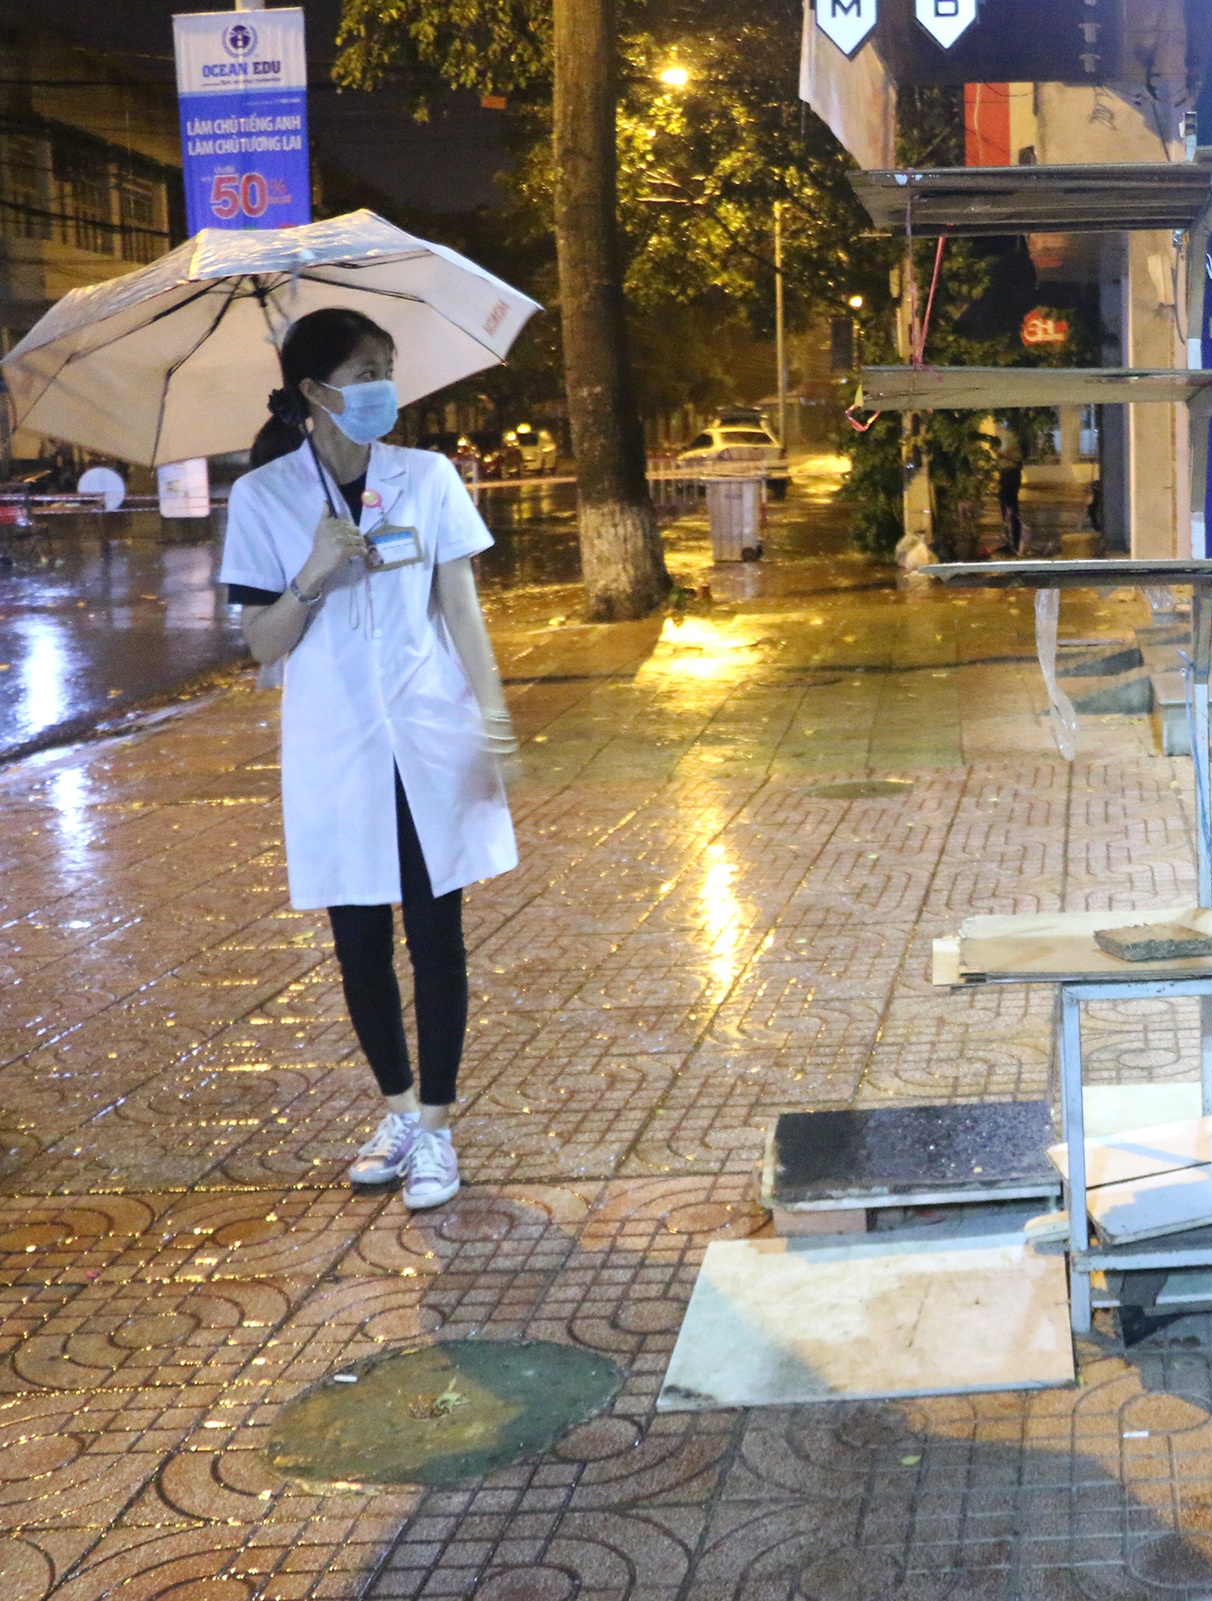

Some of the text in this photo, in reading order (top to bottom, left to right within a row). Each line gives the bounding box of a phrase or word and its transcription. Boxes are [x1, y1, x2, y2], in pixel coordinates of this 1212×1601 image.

[202, 60, 281, 78] OCEAN EDU
[186, 117, 213, 136] LÀM
[274, 114, 302, 131] ANH
[187, 137, 214, 156] LÀM
[282, 135, 302, 151] LAI
